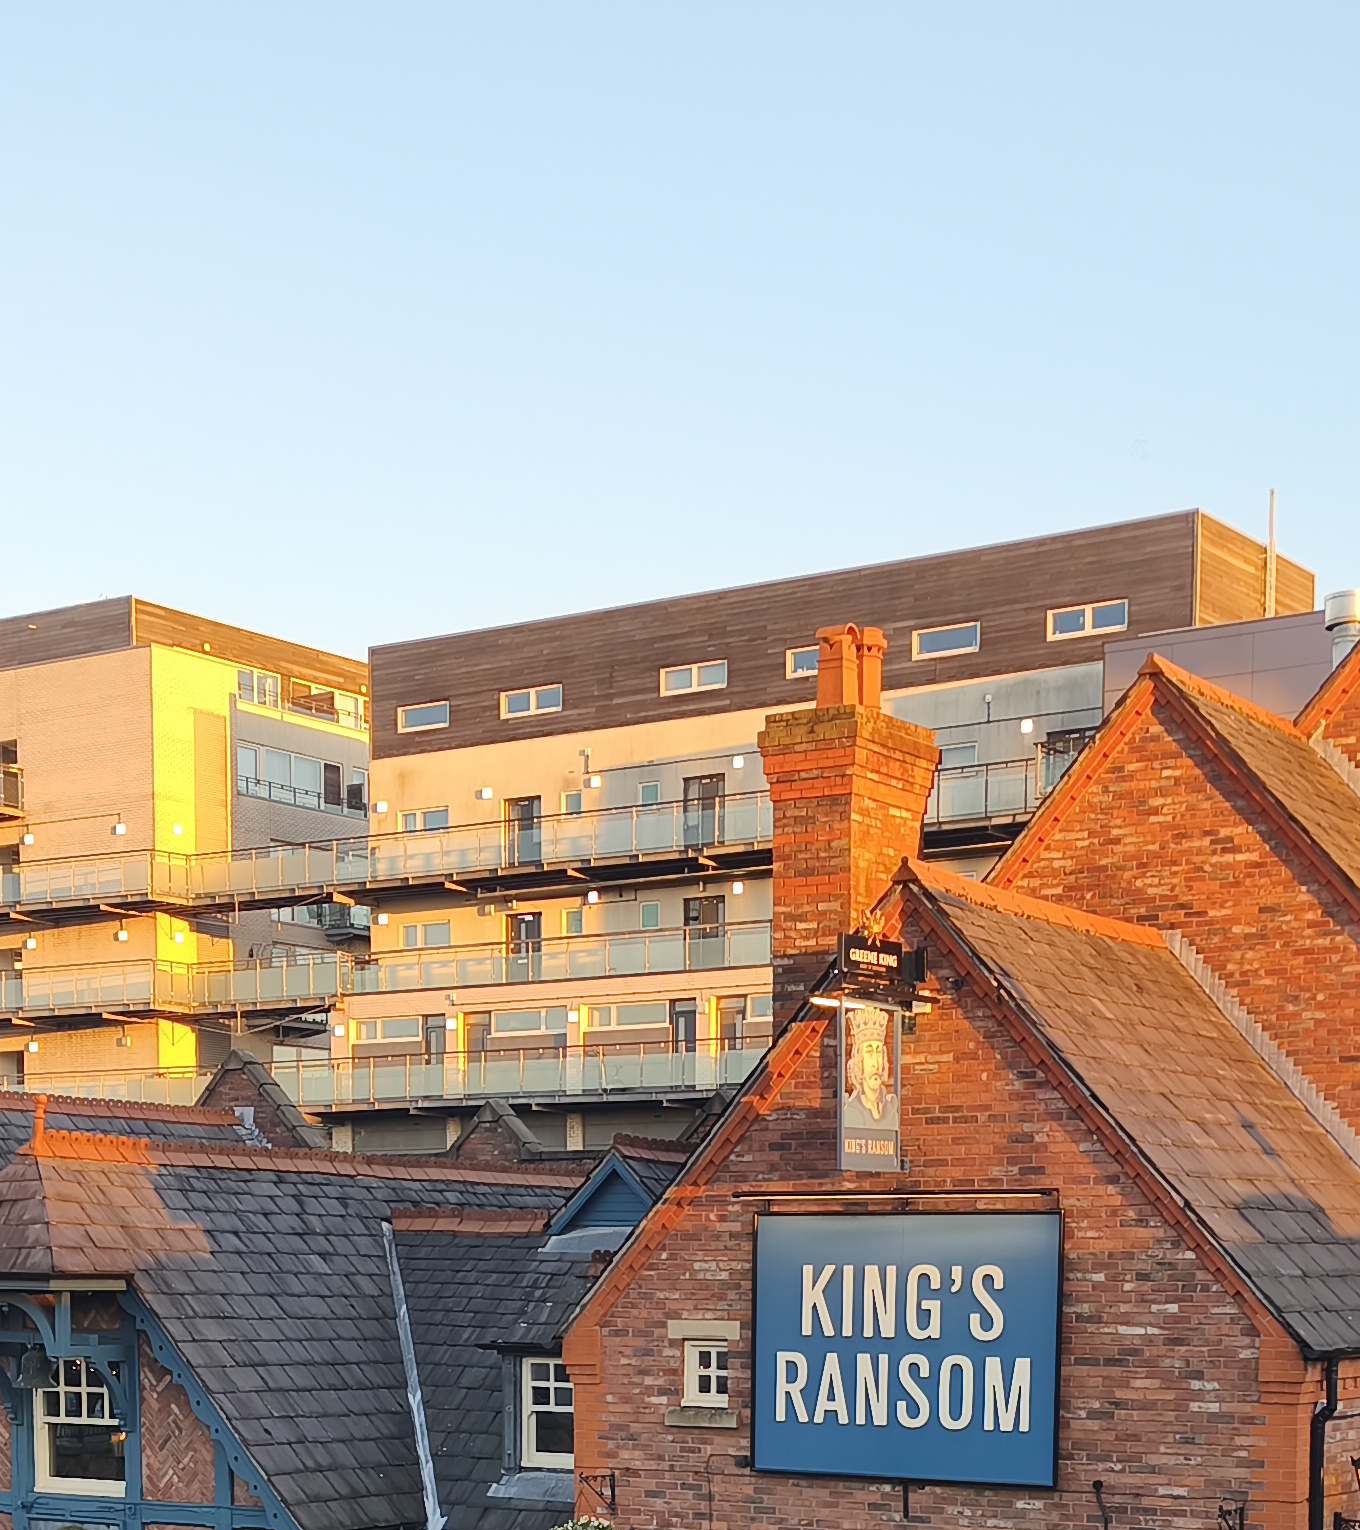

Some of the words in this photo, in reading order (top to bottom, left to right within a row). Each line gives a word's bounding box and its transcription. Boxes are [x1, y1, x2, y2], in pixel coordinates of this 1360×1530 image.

[850, 948, 878, 964] GREENE
[879, 954, 897, 967] KING
[844, 1138, 866, 1154] KING'S
[867, 1139, 894, 1156] RANSOM
[801, 1264, 1005, 1342] KING'S
[775, 1351, 1032, 1432] RANSOM
